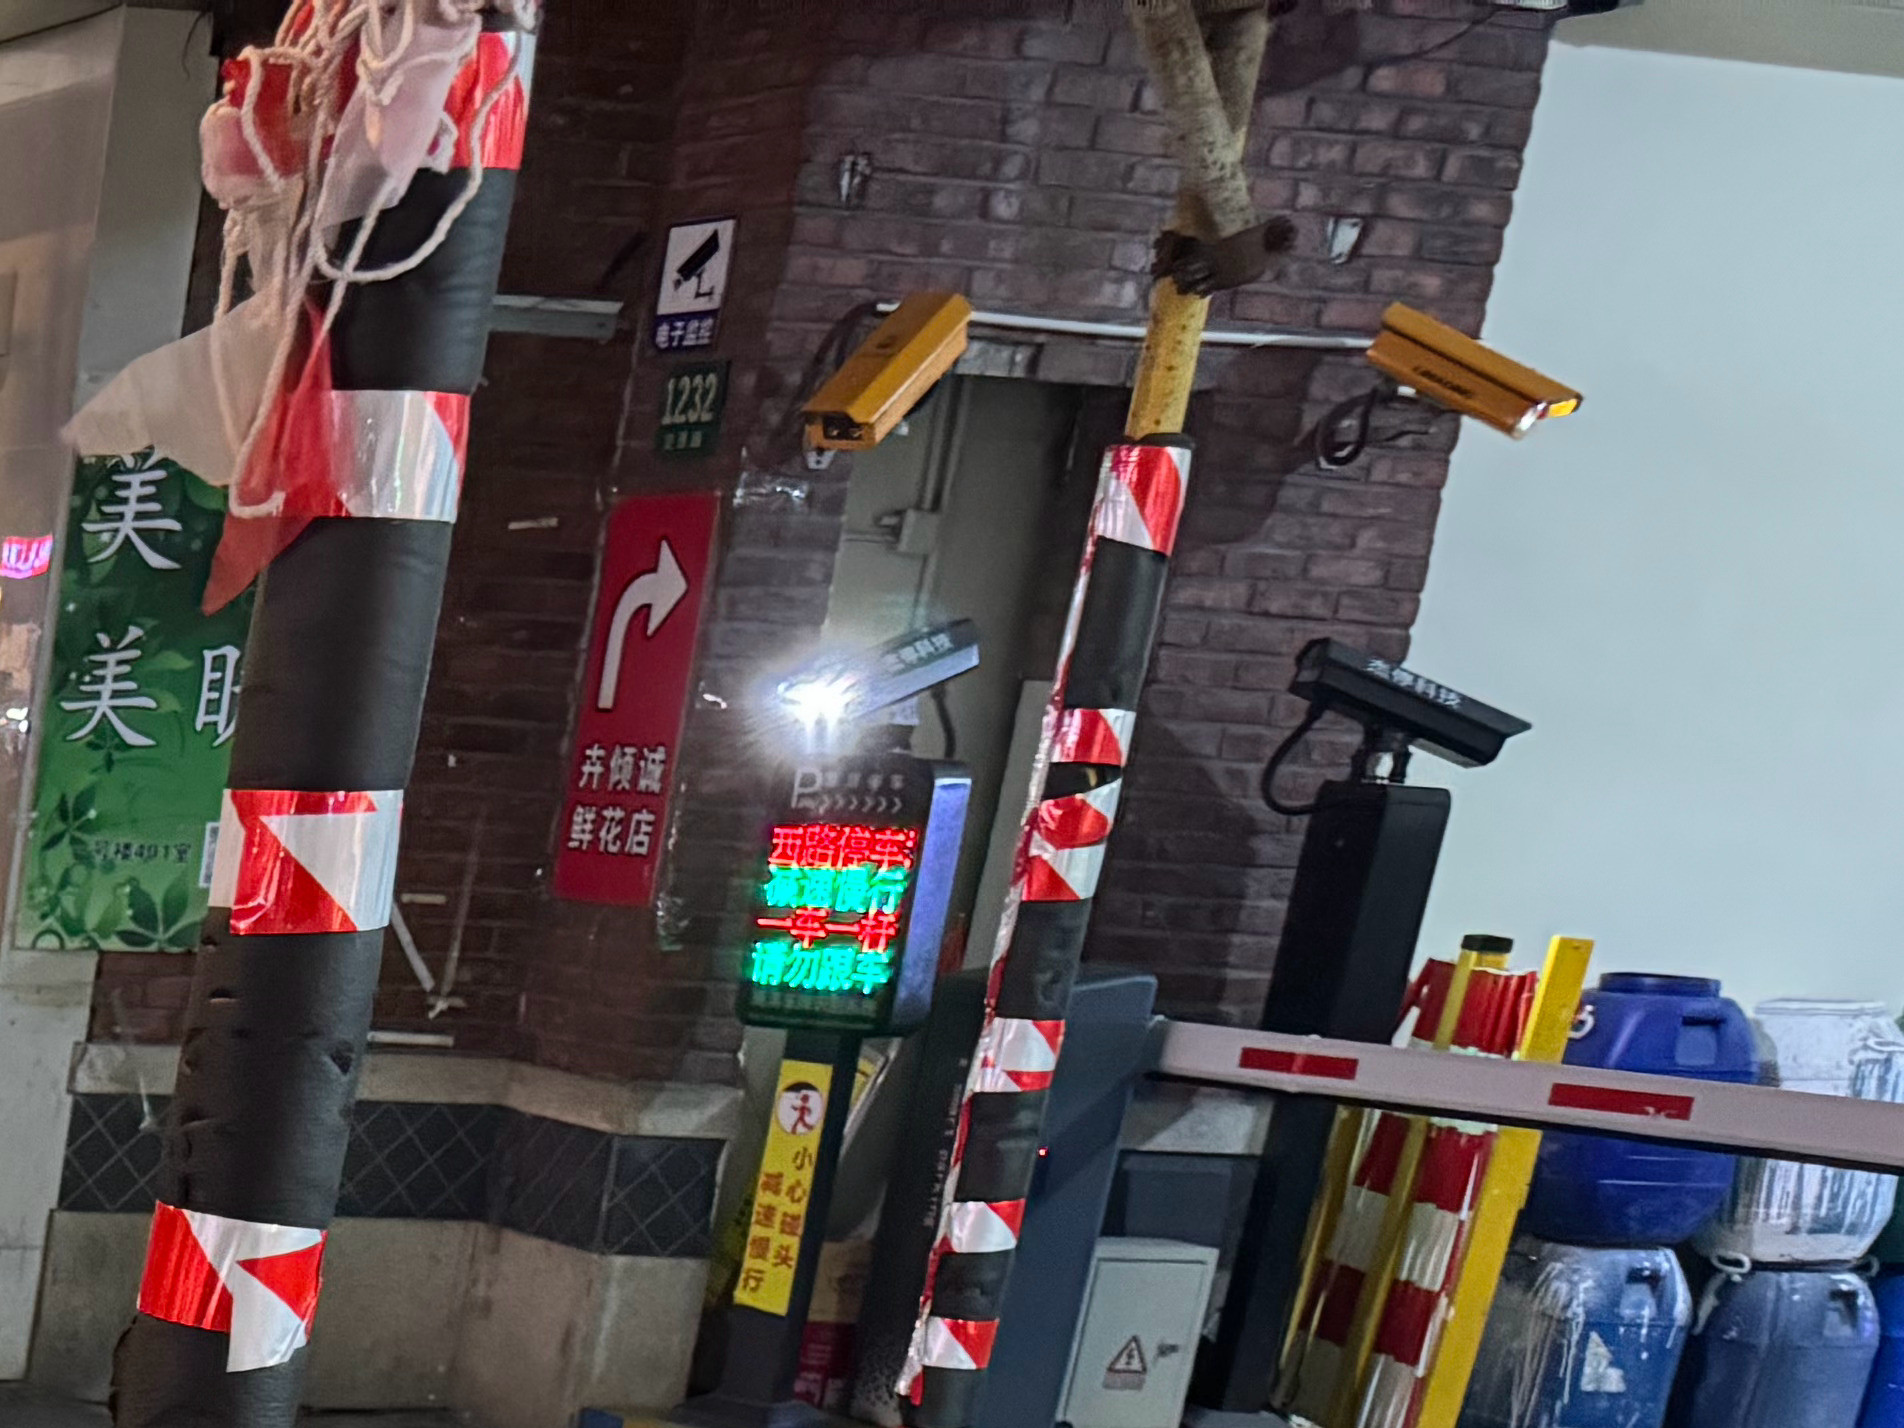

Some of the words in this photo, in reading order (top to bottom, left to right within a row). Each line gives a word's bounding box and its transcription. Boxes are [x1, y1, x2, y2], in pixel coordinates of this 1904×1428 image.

[655, 317, 715, 348] 电子监控
[661, 372, 718, 426] 1232
[567, 803, 656, 856] 鲜花店
[763, 866, 908, 915] 减速慢行
[756, 907, 900, 953] 一车一杆
[751, 941, 891, 994] 请勿跟车
[742, 1171, 785, 1292] 减速慢行
